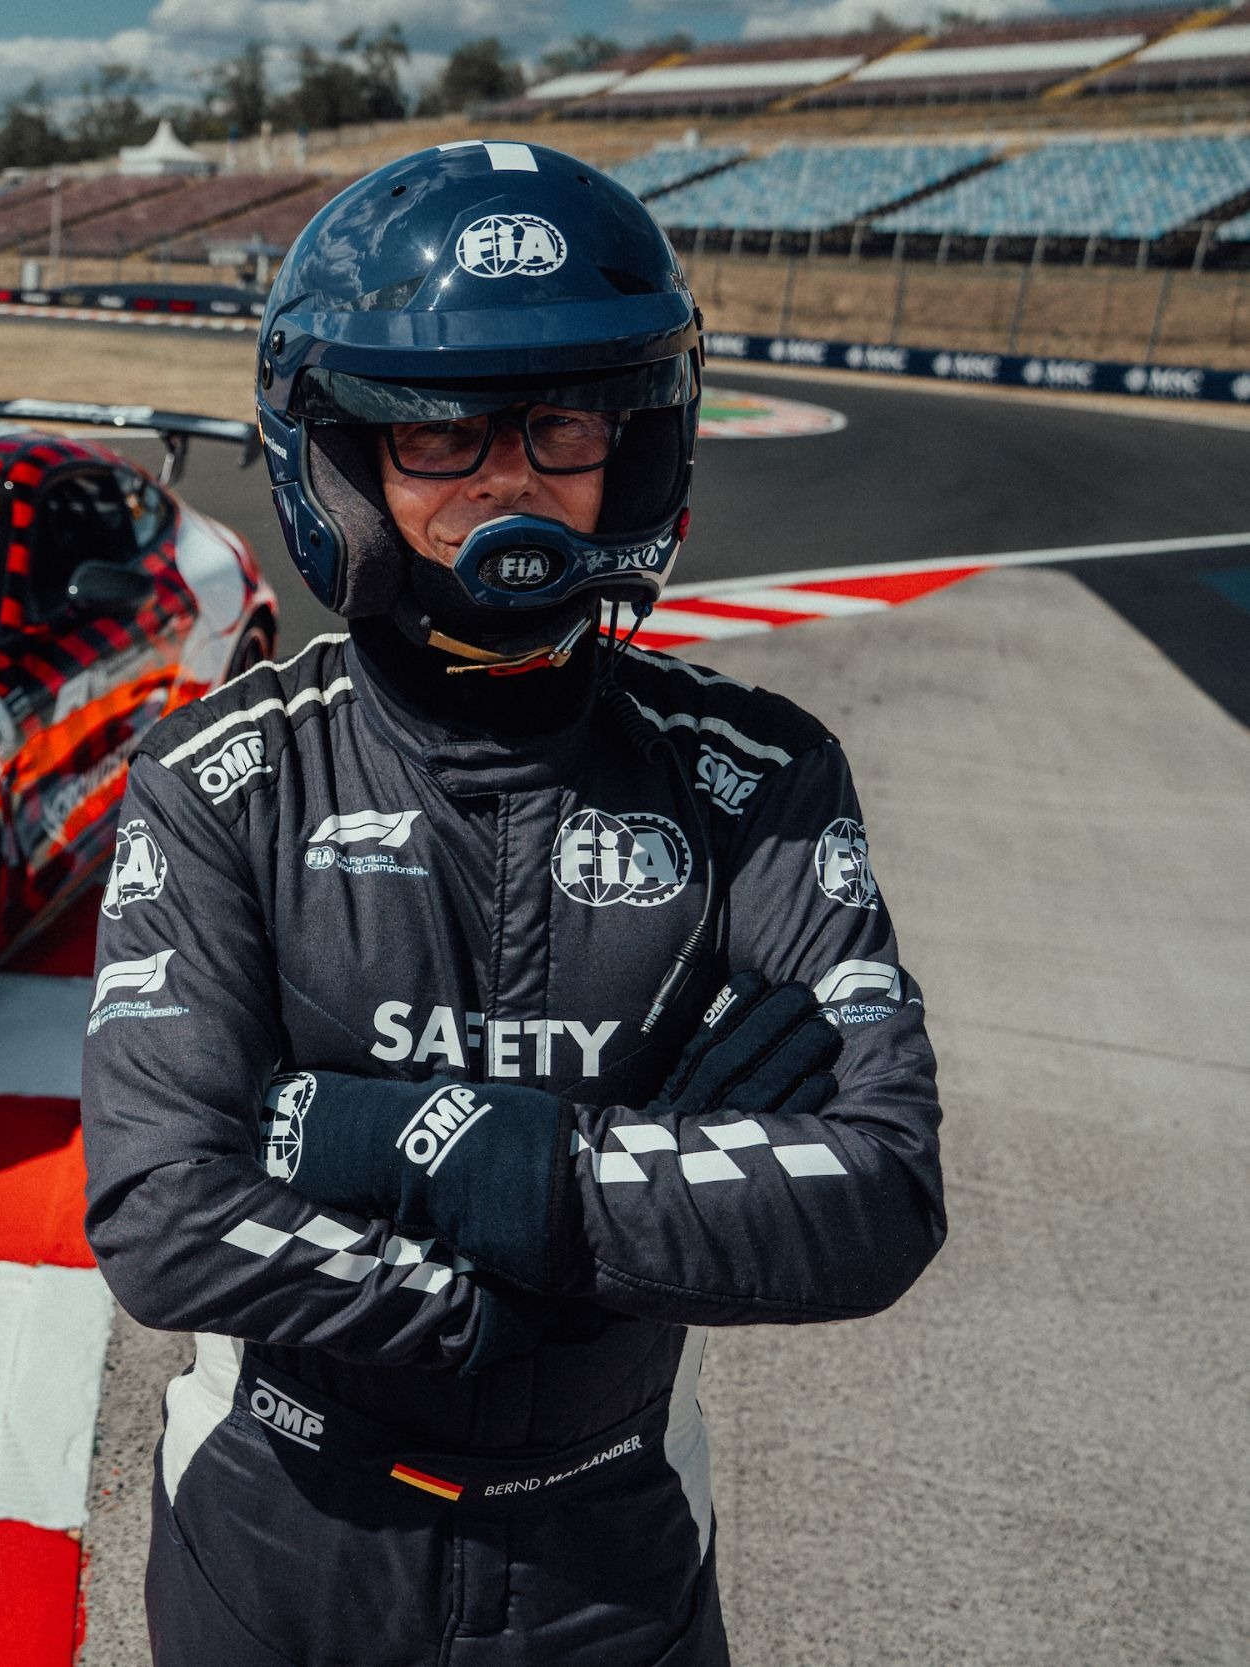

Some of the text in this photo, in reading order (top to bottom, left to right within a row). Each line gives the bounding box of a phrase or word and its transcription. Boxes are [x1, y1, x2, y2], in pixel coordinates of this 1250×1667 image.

[198, 736, 266, 794] OMP
[695, 753, 758, 807] OMP
[349, 854, 388, 865] Formula
[703, 987, 732, 1023] OMP
[841, 1004, 859, 1015] FIA
[841, 1013, 875, 1024] World
[370, 1000, 622, 1077] SAFETY
[405, 1087, 476, 1164] OMP
[251, 1389, 323, 1438] OMP
[484, 1478, 540, 1496] BERND
